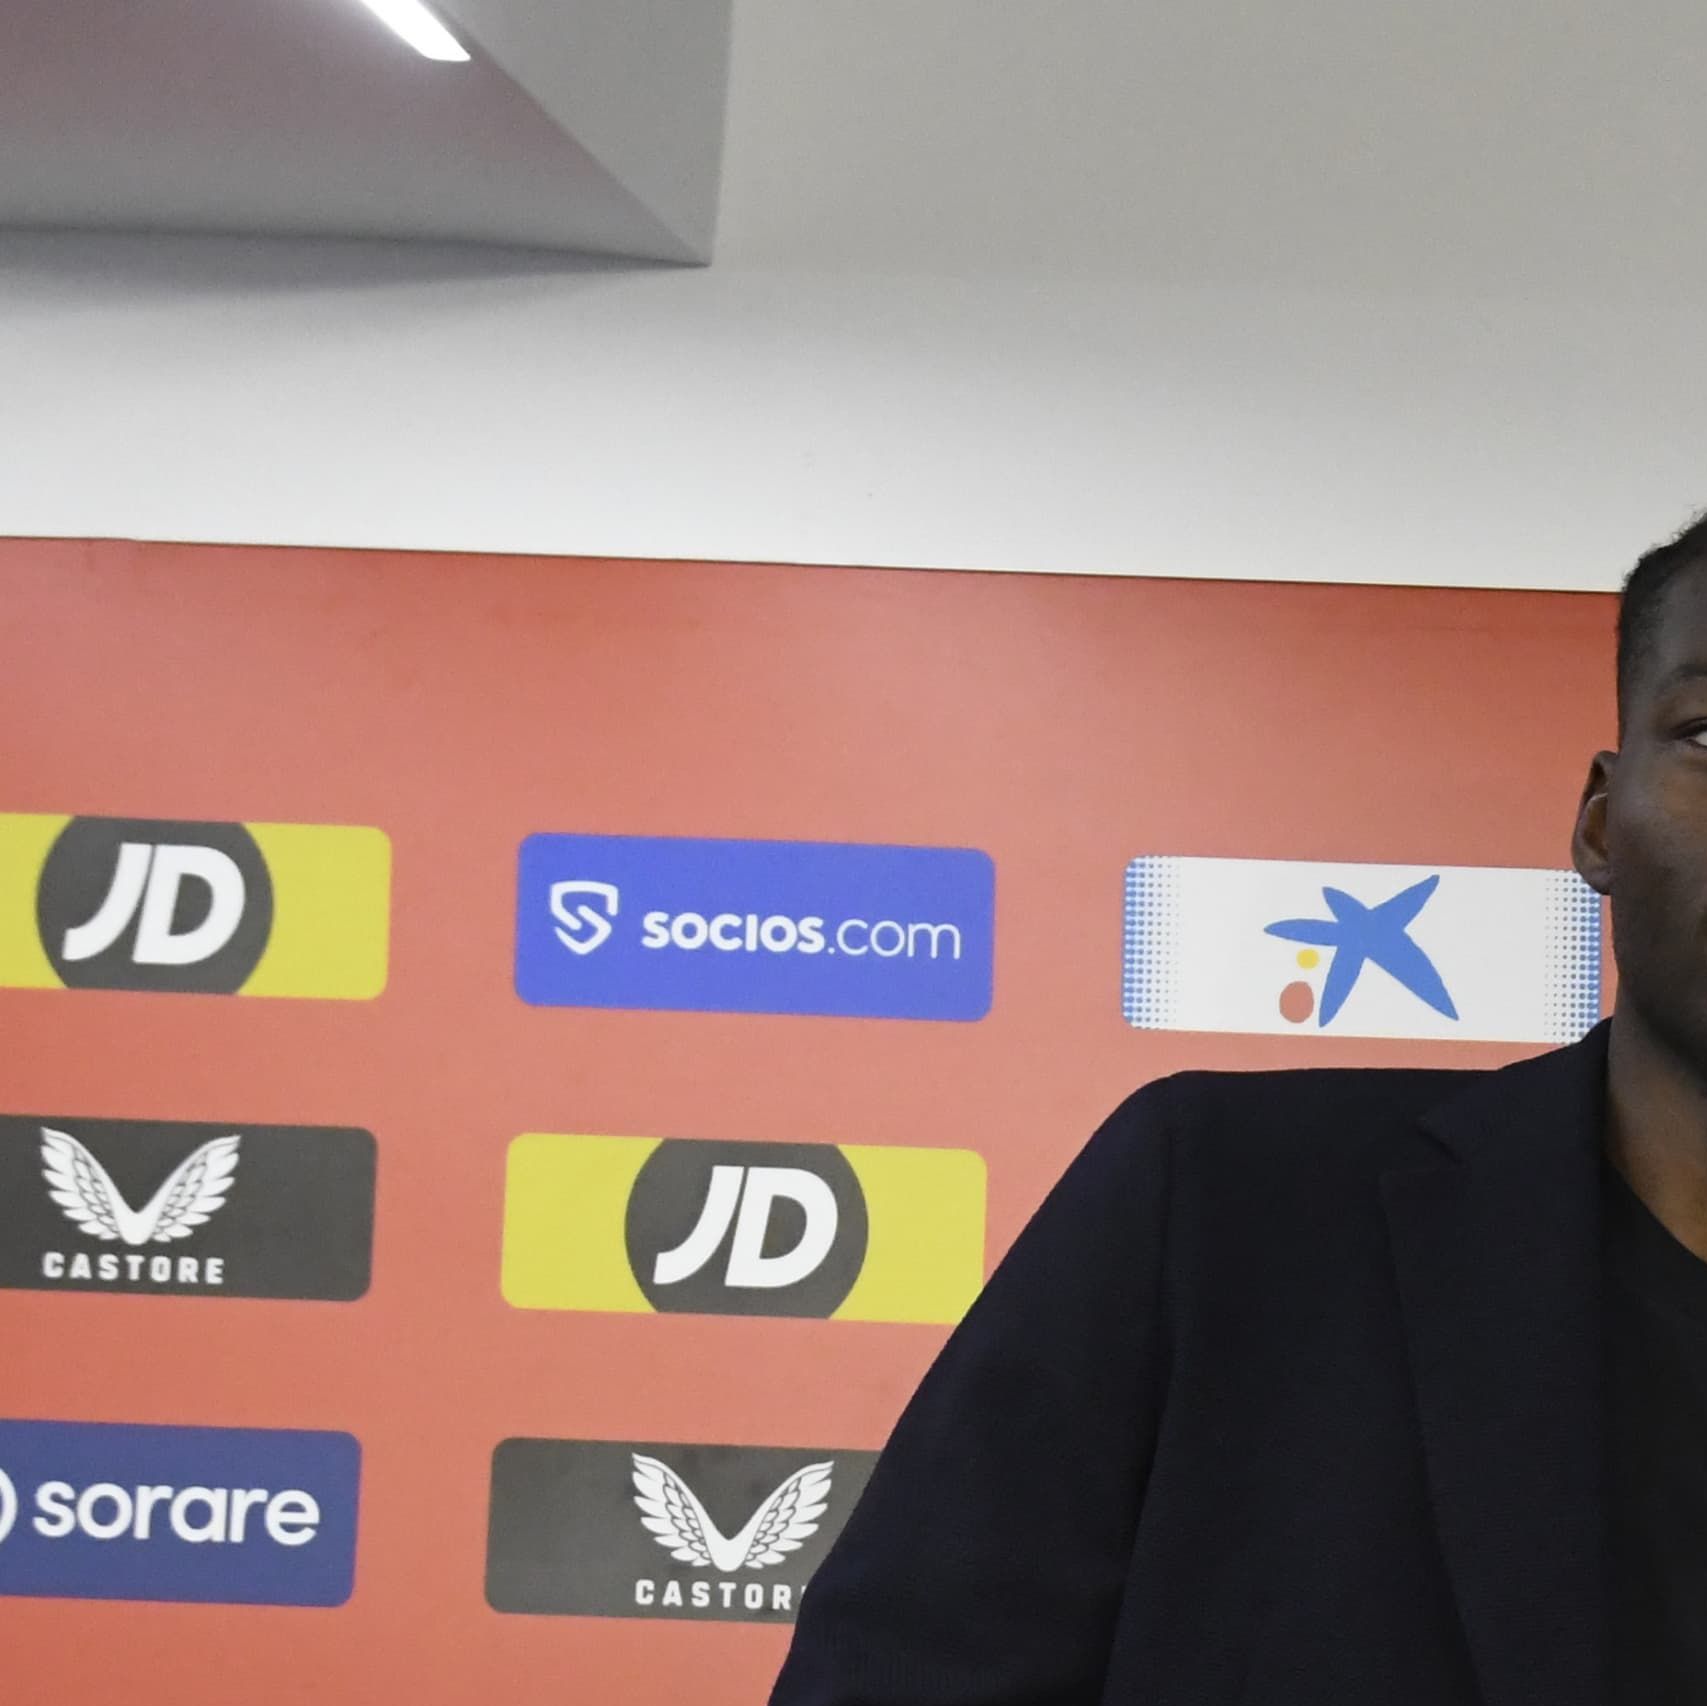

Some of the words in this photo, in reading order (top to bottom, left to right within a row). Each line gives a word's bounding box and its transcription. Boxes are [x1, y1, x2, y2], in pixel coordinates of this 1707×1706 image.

[63, 843, 244, 964] JD
[654, 1166, 838, 1288] JD
[43, 1251, 224, 1285] CASTORE
[33, 1481, 320, 1546] sorare
[635, 1579, 807, 1611] CASTOR
